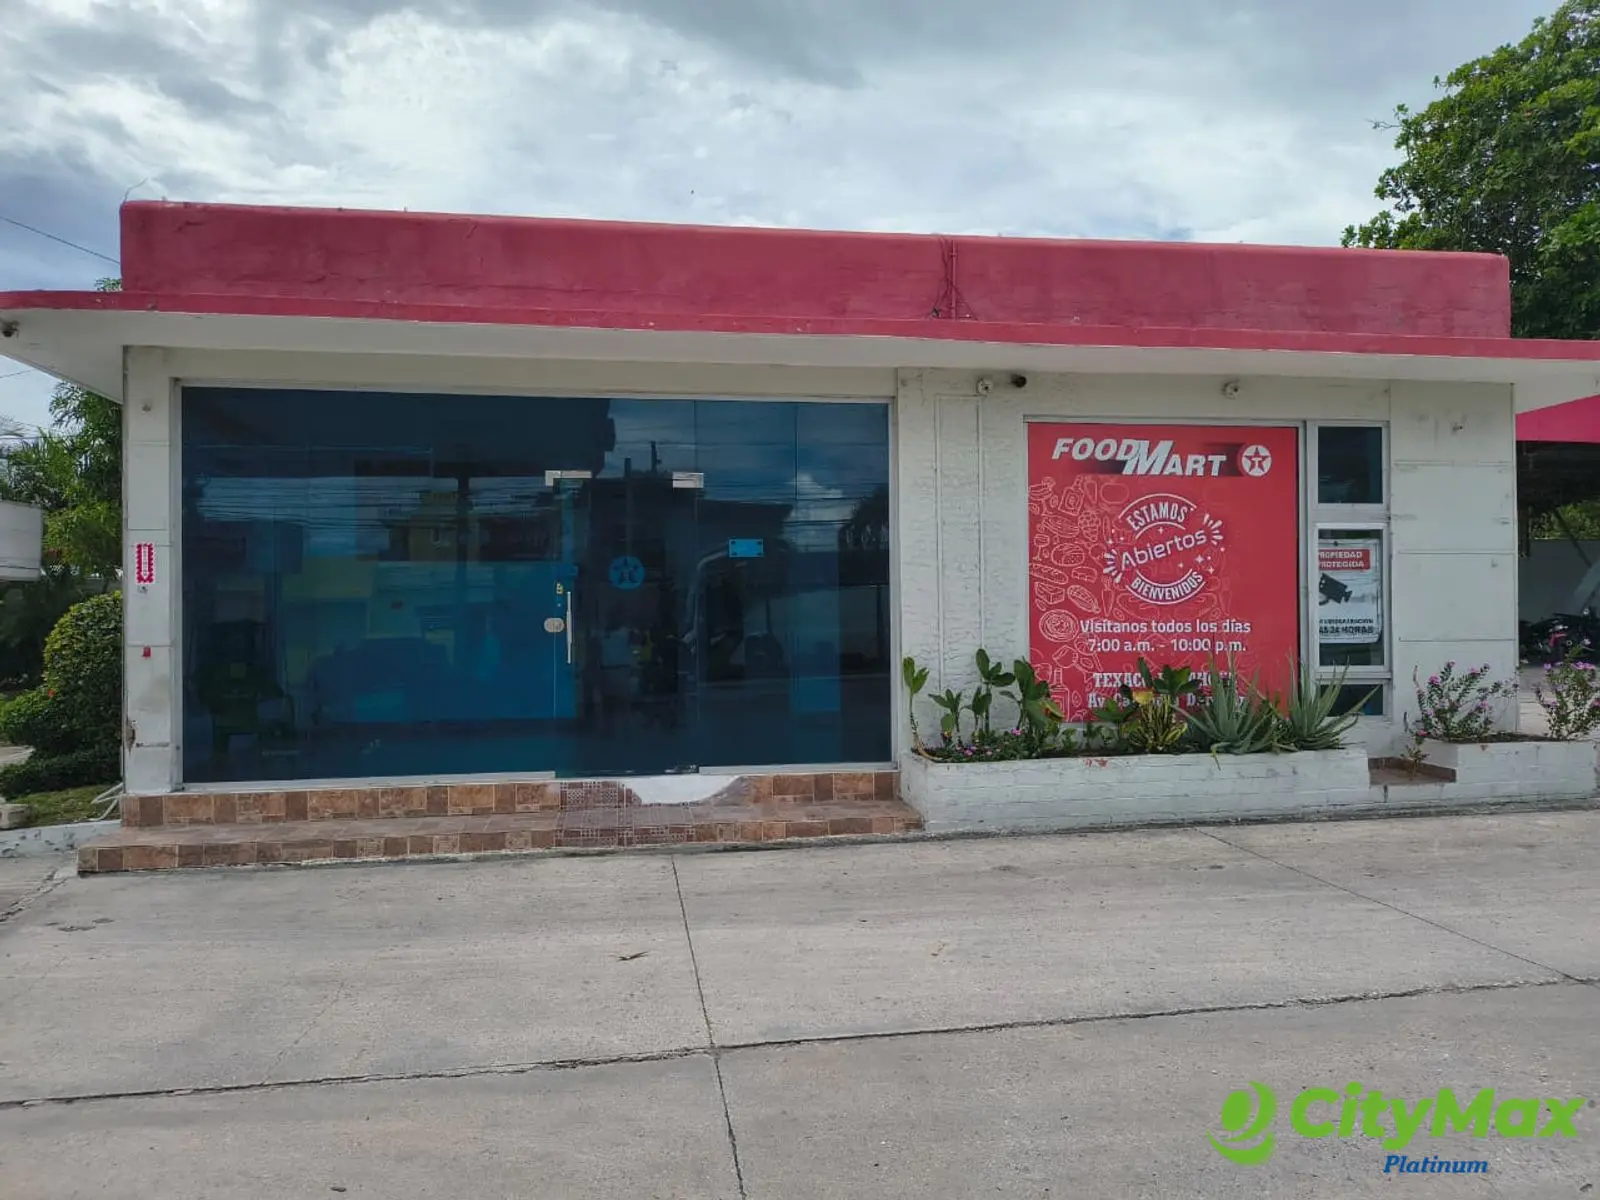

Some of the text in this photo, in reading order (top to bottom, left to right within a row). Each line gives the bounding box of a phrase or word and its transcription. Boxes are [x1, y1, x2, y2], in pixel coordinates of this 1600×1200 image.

[1126, 502, 1188, 530] ESTAMOS
[1121, 529, 1208, 571] Abiertos
[1131, 571, 1204, 601] BIENVENIDOS
[1152, 620, 1192, 632] todos
[1196, 619, 1217, 632] los
[1088, 638, 1121, 651] 7:00
[1124, 641, 1155, 651] a.m.
[1171, 638, 1211, 651] 10:00
[1215, 640, 1247, 655] p.m.
[1093, 672, 1147, 688] TEXAC
